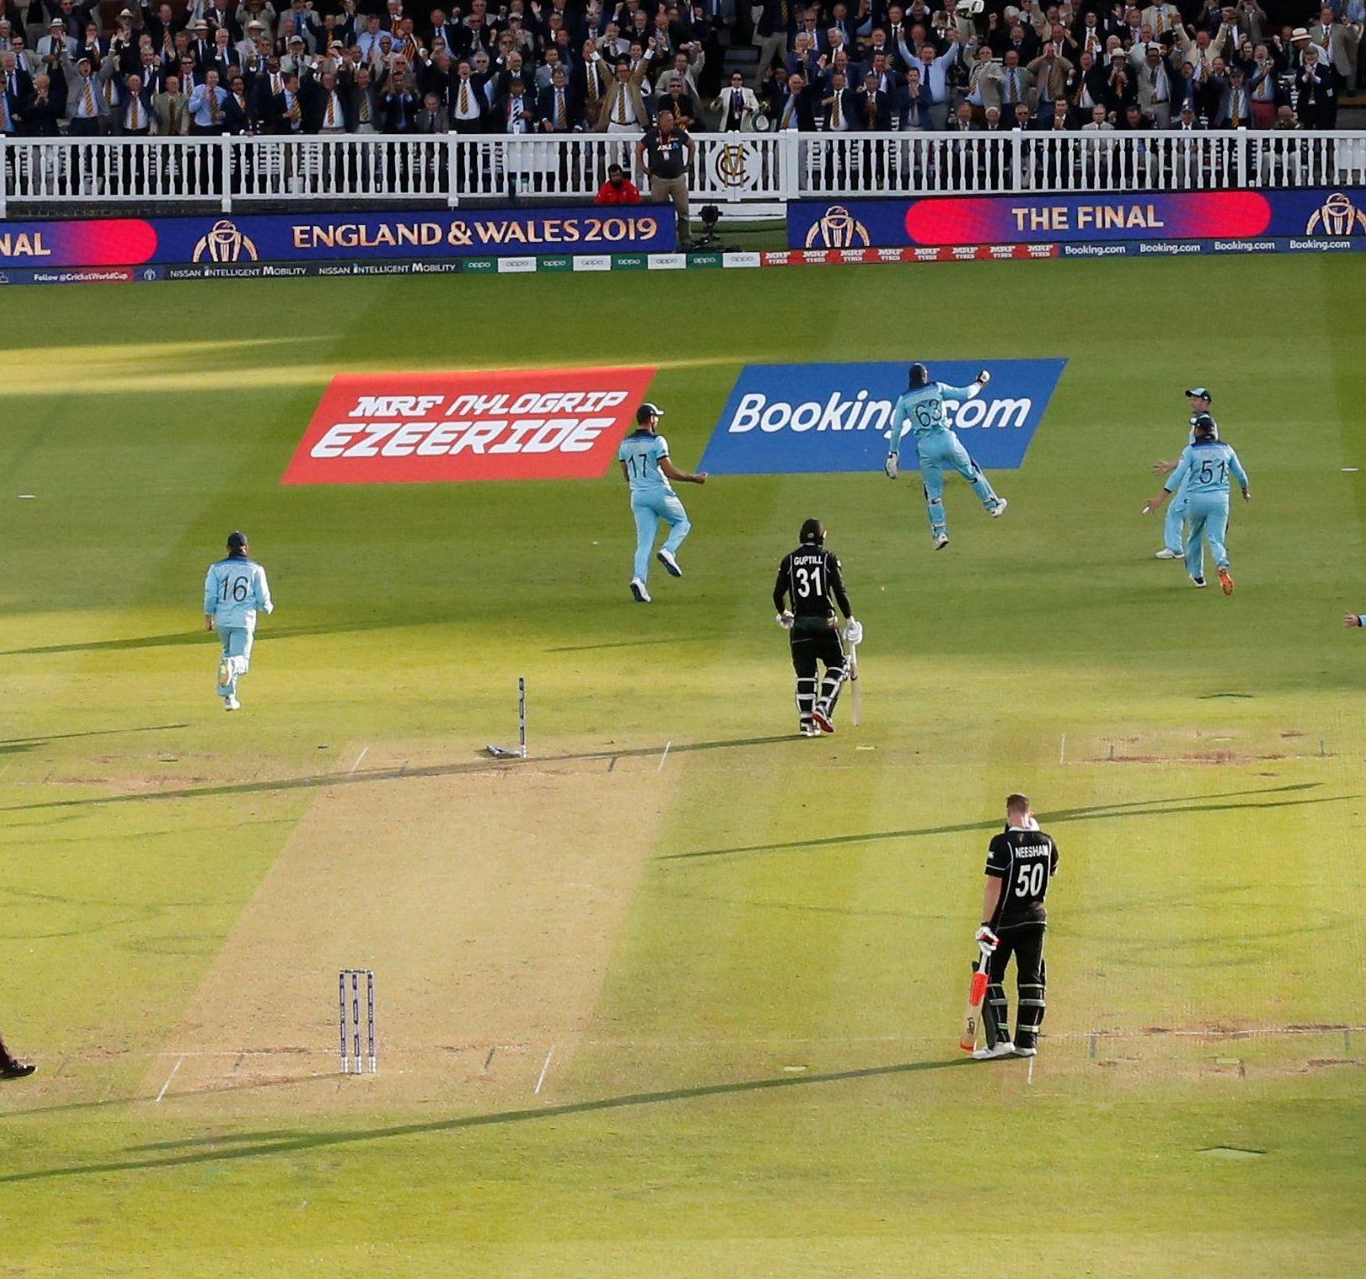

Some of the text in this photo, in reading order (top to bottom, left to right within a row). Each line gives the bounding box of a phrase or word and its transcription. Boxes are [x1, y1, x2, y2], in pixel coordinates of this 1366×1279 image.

[1011, 205, 1164, 232] THE FINAL
[292, 224, 442, 248] ENGLAND
[473, 219, 580, 243] WALES
[584, 217, 658, 241] 2019
[1289, 239, 1350, 251] Booking.com
[1065, 244, 1126, 256] Booking.com
[1140, 242, 1200, 254] Booking.com
[1214, 241, 1275, 252] Booking.com
[348, 395, 444, 418] MRF
[914, 399, 943, 429] 63
[309, 417, 617, 458] EZEERIDE
[628, 453, 647, 479] 17
[1199, 460, 1225, 484] 51
[793, 555, 823, 566] GUPTILL
[221, 576, 248, 602] 16
[796, 567, 822, 598] 31
[1015, 863, 1044, 898] 50
